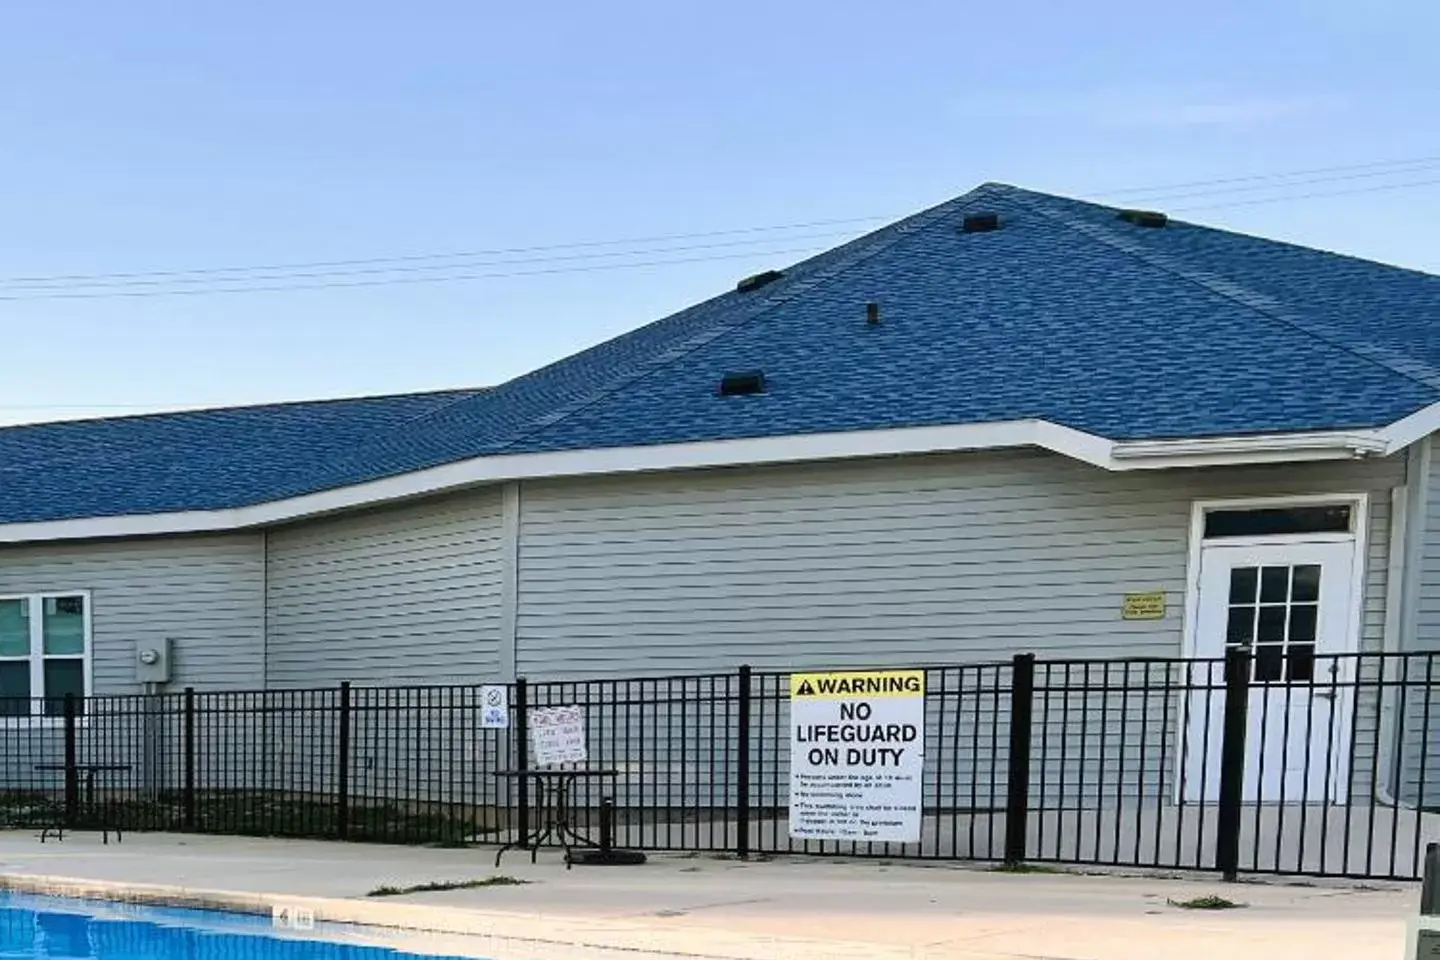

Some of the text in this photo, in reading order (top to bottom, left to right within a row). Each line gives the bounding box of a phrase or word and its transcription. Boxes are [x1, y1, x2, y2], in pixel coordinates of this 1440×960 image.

[817, 677, 921, 693] WARNING
[840, 702, 872, 721] NO
[797, 724, 917, 742] LIFEGUARD
[808, 748, 905, 766] ON DUTY
